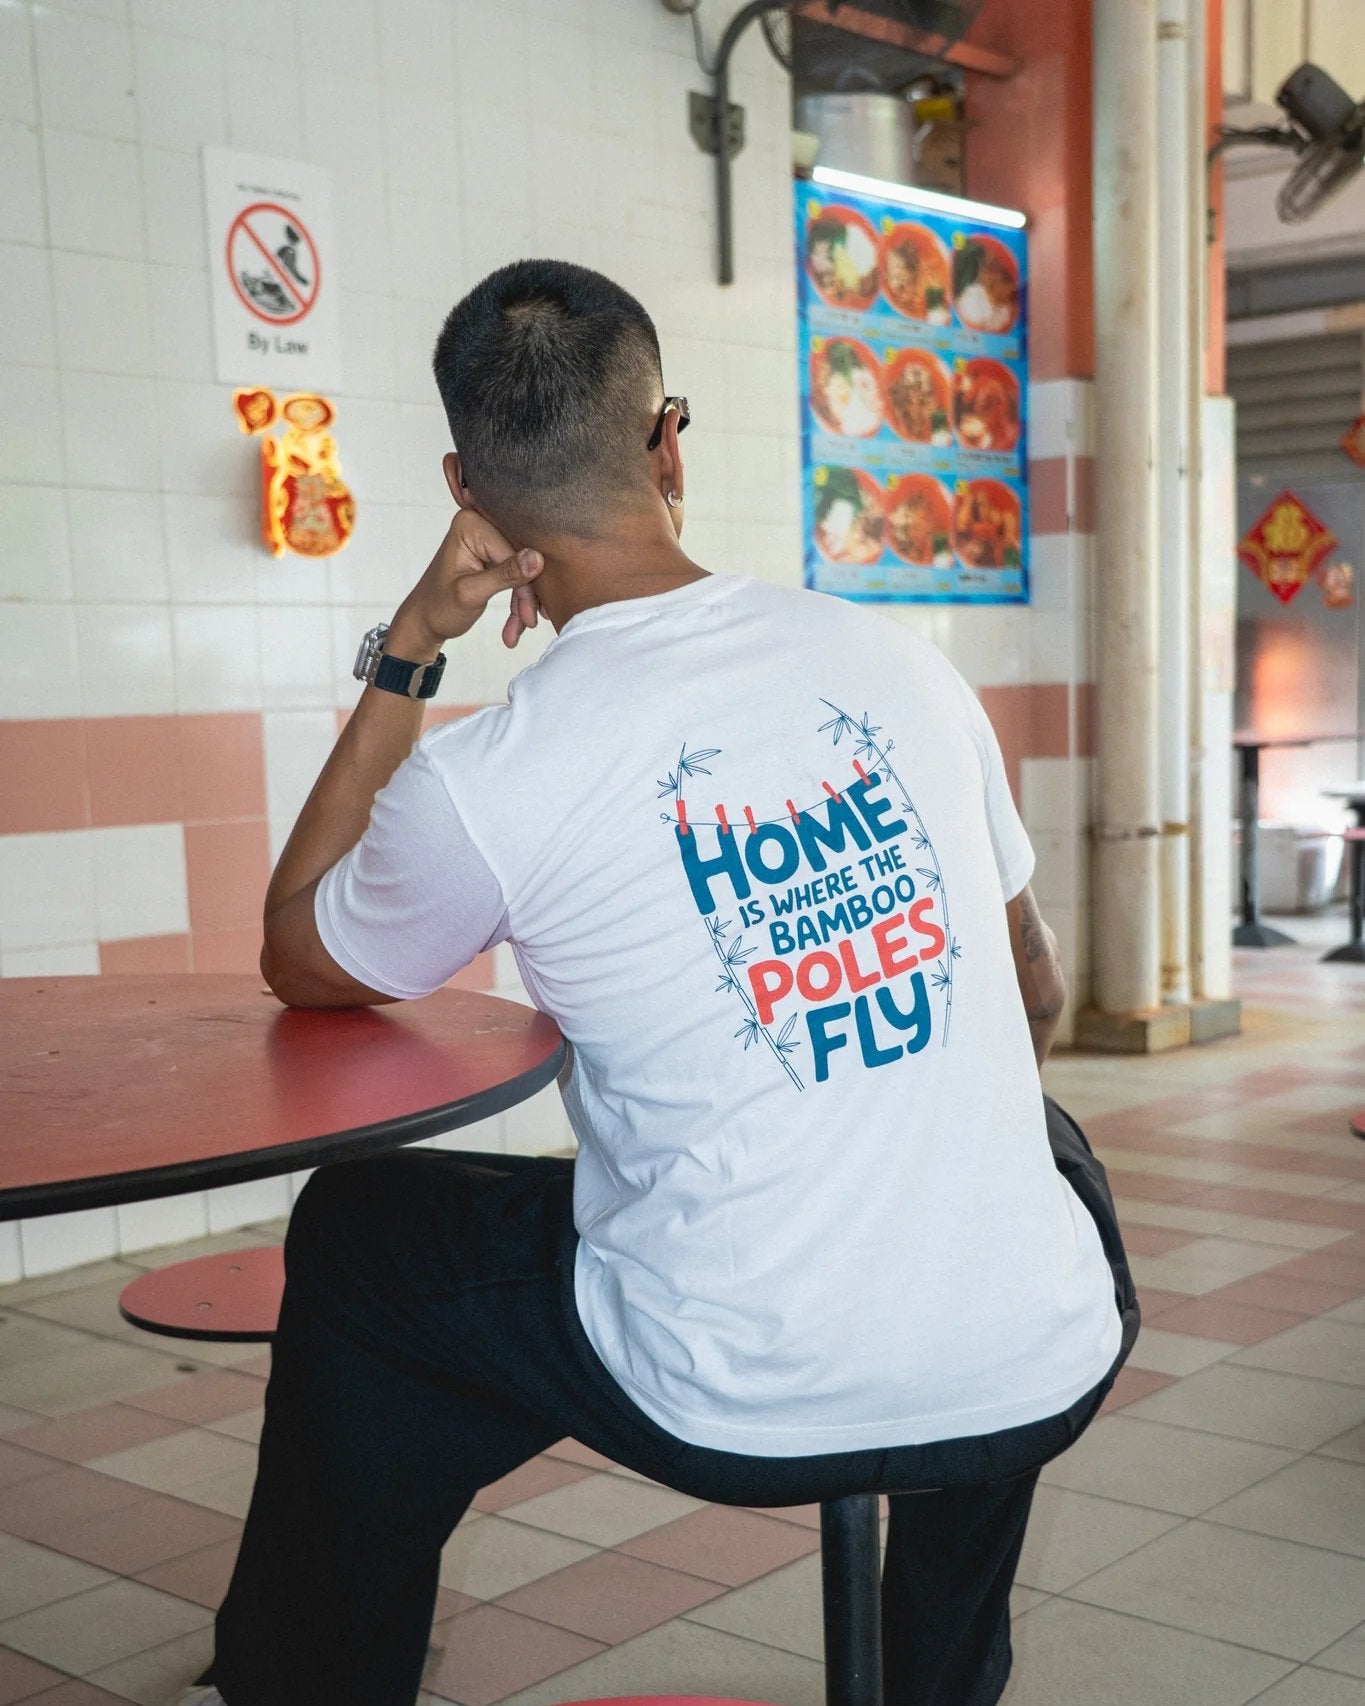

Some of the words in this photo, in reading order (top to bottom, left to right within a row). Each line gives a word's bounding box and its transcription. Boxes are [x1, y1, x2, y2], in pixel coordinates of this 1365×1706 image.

[247, 332, 269, 357] By
[274, 335, 309, 355] Law
[675, 772, 907, 916] HOME
[739, 900, 764, 929] IS
[769, 866, 855, 917] WHERE
[858, 844, 907, 882] THE
[748, 898, 945, 1025] POLES
[769, 875, 916, 956] BAMBOO
[806, 972, 931, 1083] FLY
